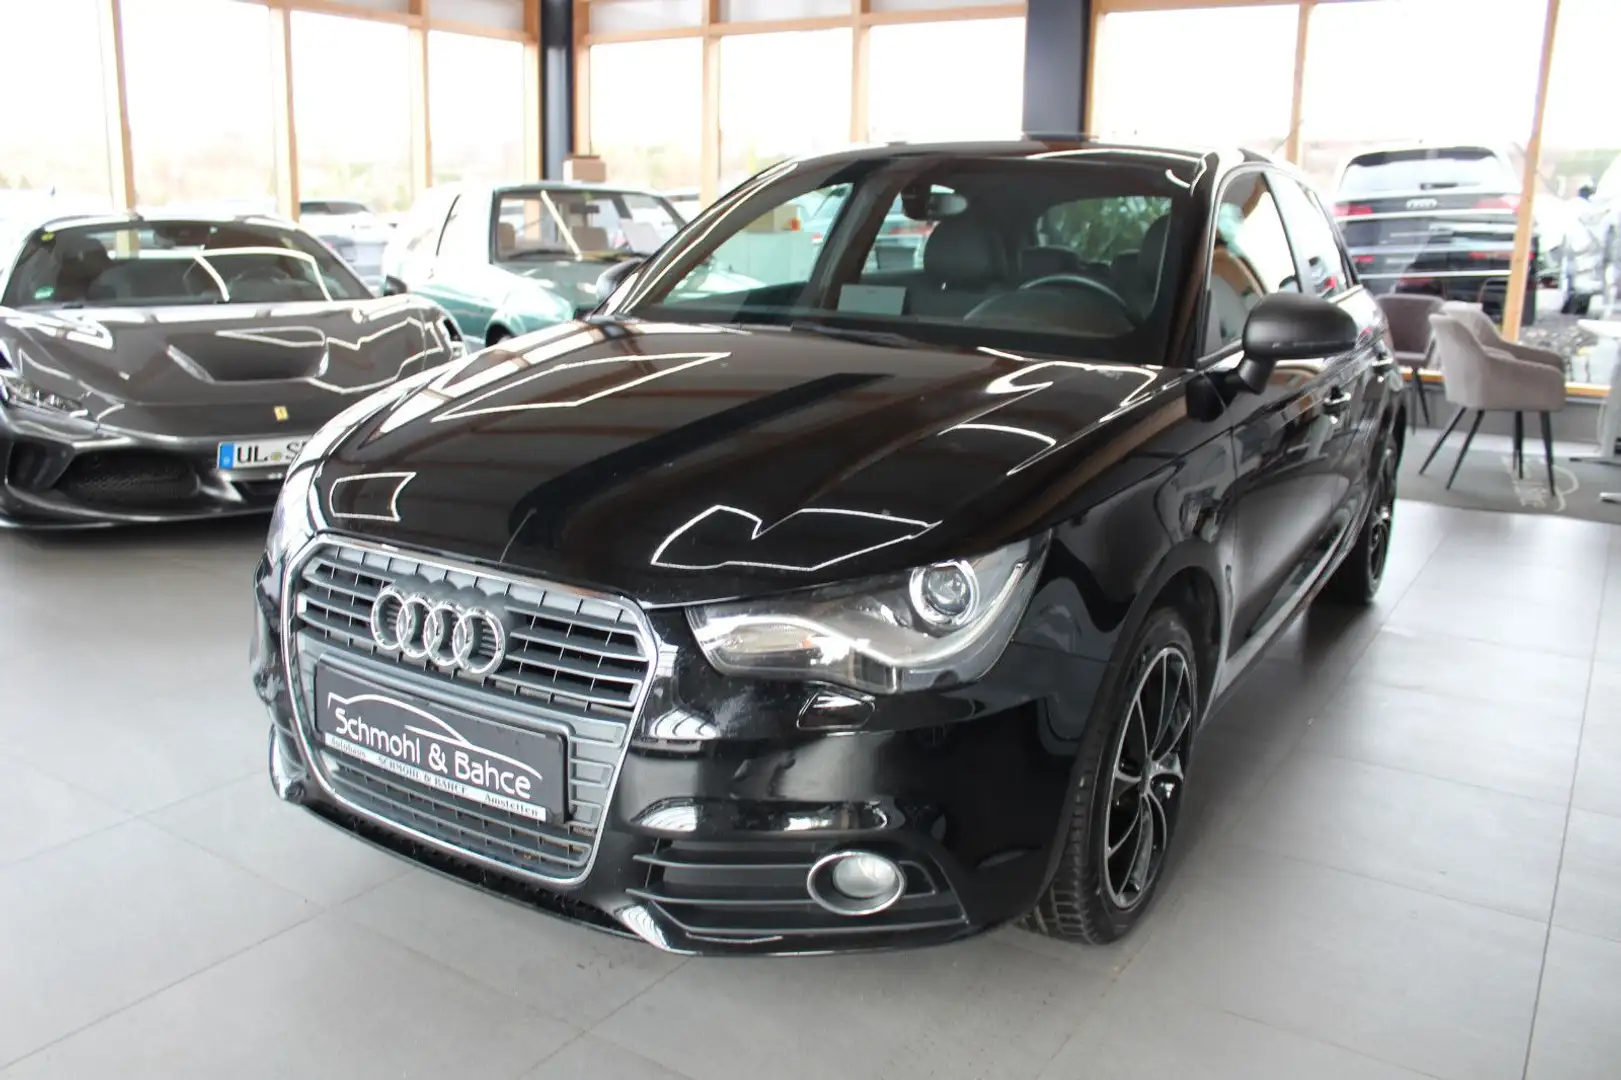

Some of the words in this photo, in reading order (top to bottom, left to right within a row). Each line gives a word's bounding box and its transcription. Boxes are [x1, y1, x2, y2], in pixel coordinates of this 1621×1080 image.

[237, 445, 268, 463] UL
[335, 707, 420, 764] Schmohl
[428, 743, 449, 774] &
[454, 751, 531, 799] Bahce
